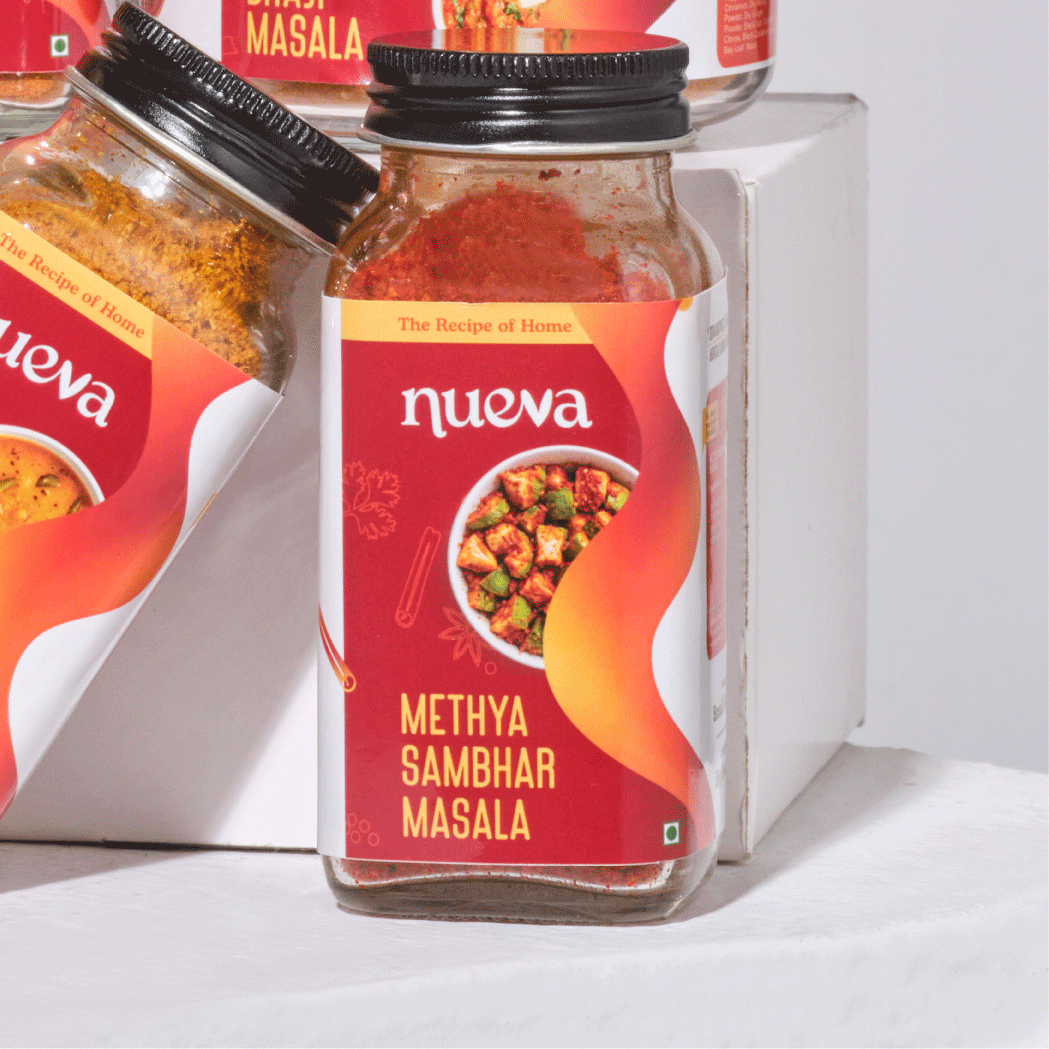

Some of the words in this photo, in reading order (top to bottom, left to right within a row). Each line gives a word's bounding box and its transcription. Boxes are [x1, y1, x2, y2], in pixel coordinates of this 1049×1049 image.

[247, 11, 364, 61] MASALA
[0, 232, 27, 260] The
[28, 253, 80, 295] Recipe
[82, 292, 102, 308] of
[100, 300, 146, 339] Home
[398, 317, 430, 333] The
[436, 318, 493, 335] Recipe
[498, 318, 516, 333] of
[521, 319, 573, 334] Home
[401, 387, 593, 439] nueva
[401, 693, 528, 737] METHYA
[401, 744, 555, 790] SAMBHAR
[402, 796, 531, 842] MASALA
